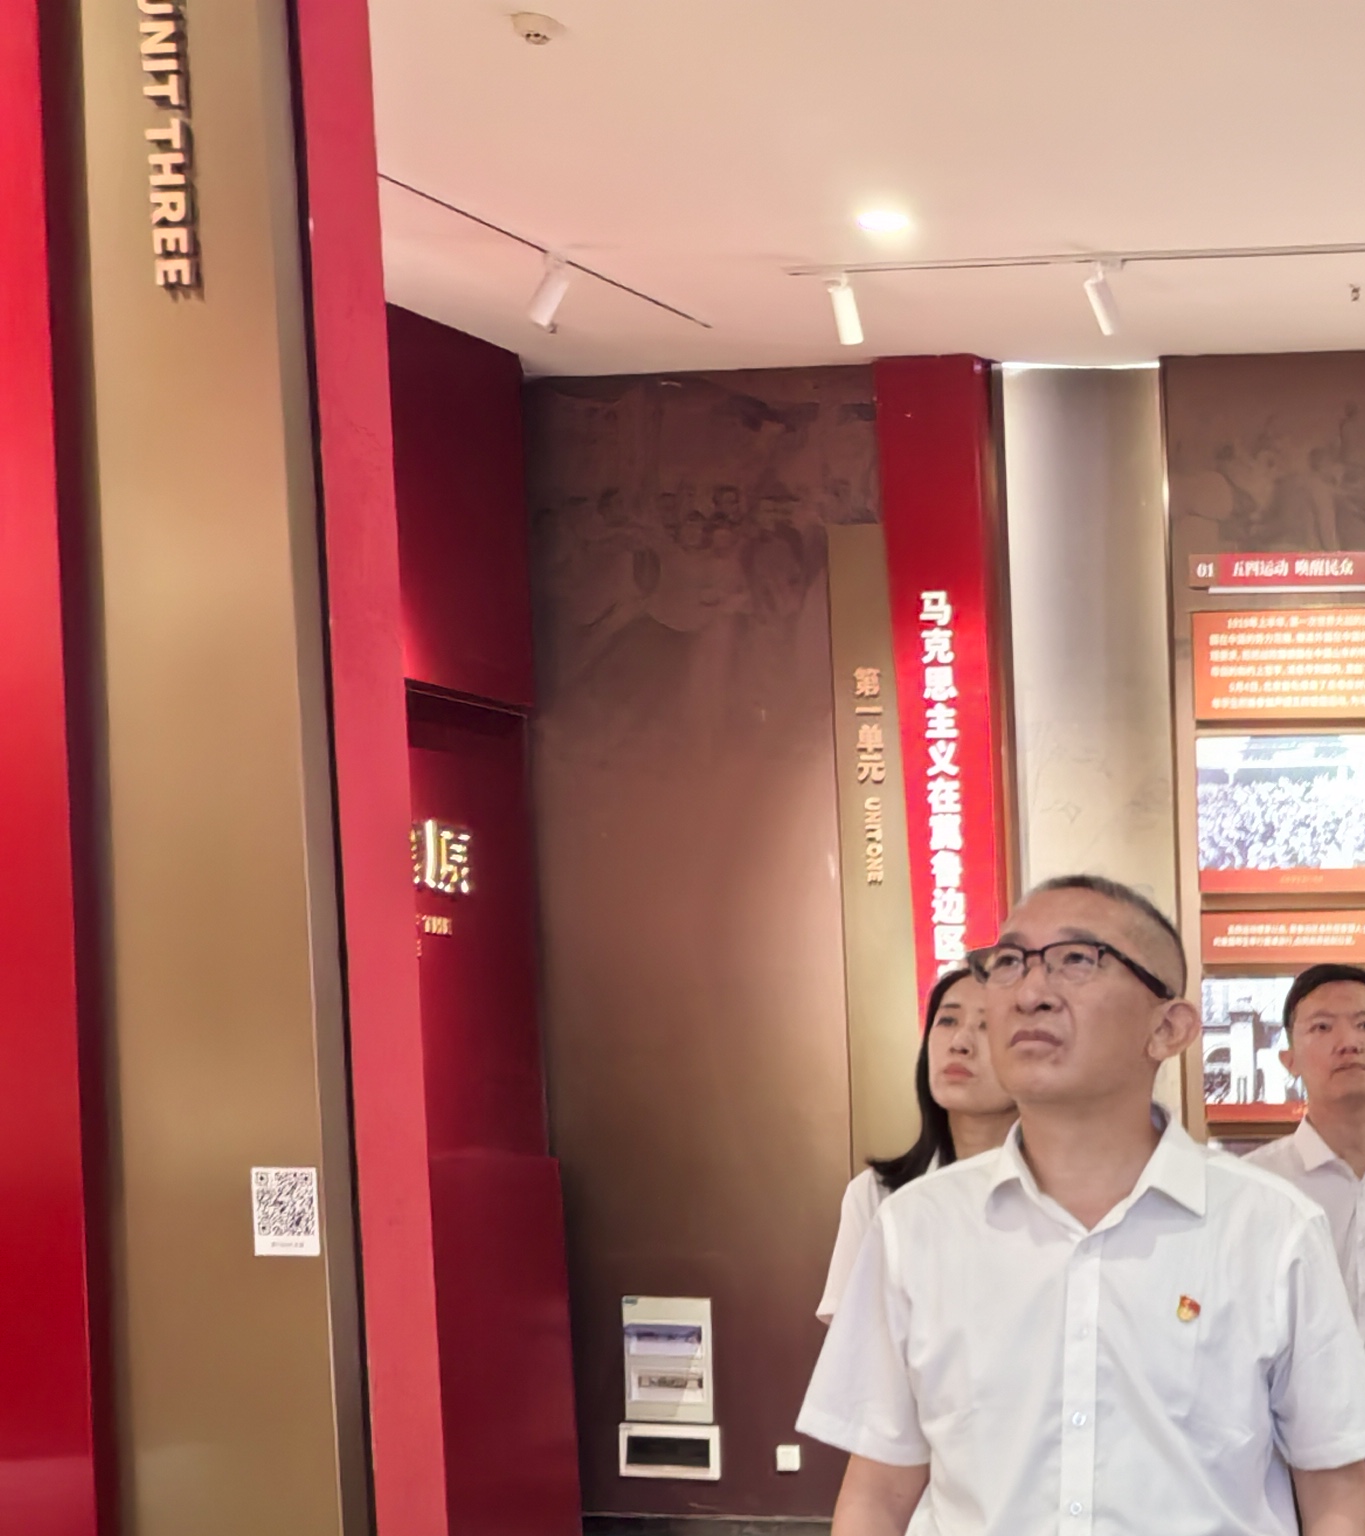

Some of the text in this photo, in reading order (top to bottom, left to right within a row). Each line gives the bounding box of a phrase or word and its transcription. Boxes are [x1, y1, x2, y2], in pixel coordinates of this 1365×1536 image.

[145, 118, 190, 285] THREE
[1196, 563, 1214, 578] 01
[1232, 560, 1289, 577] 五四运动
[853, 667, 886, 784] 第一单元
[919, 590, 967, 978] 马克思主义在冀鲁边区
